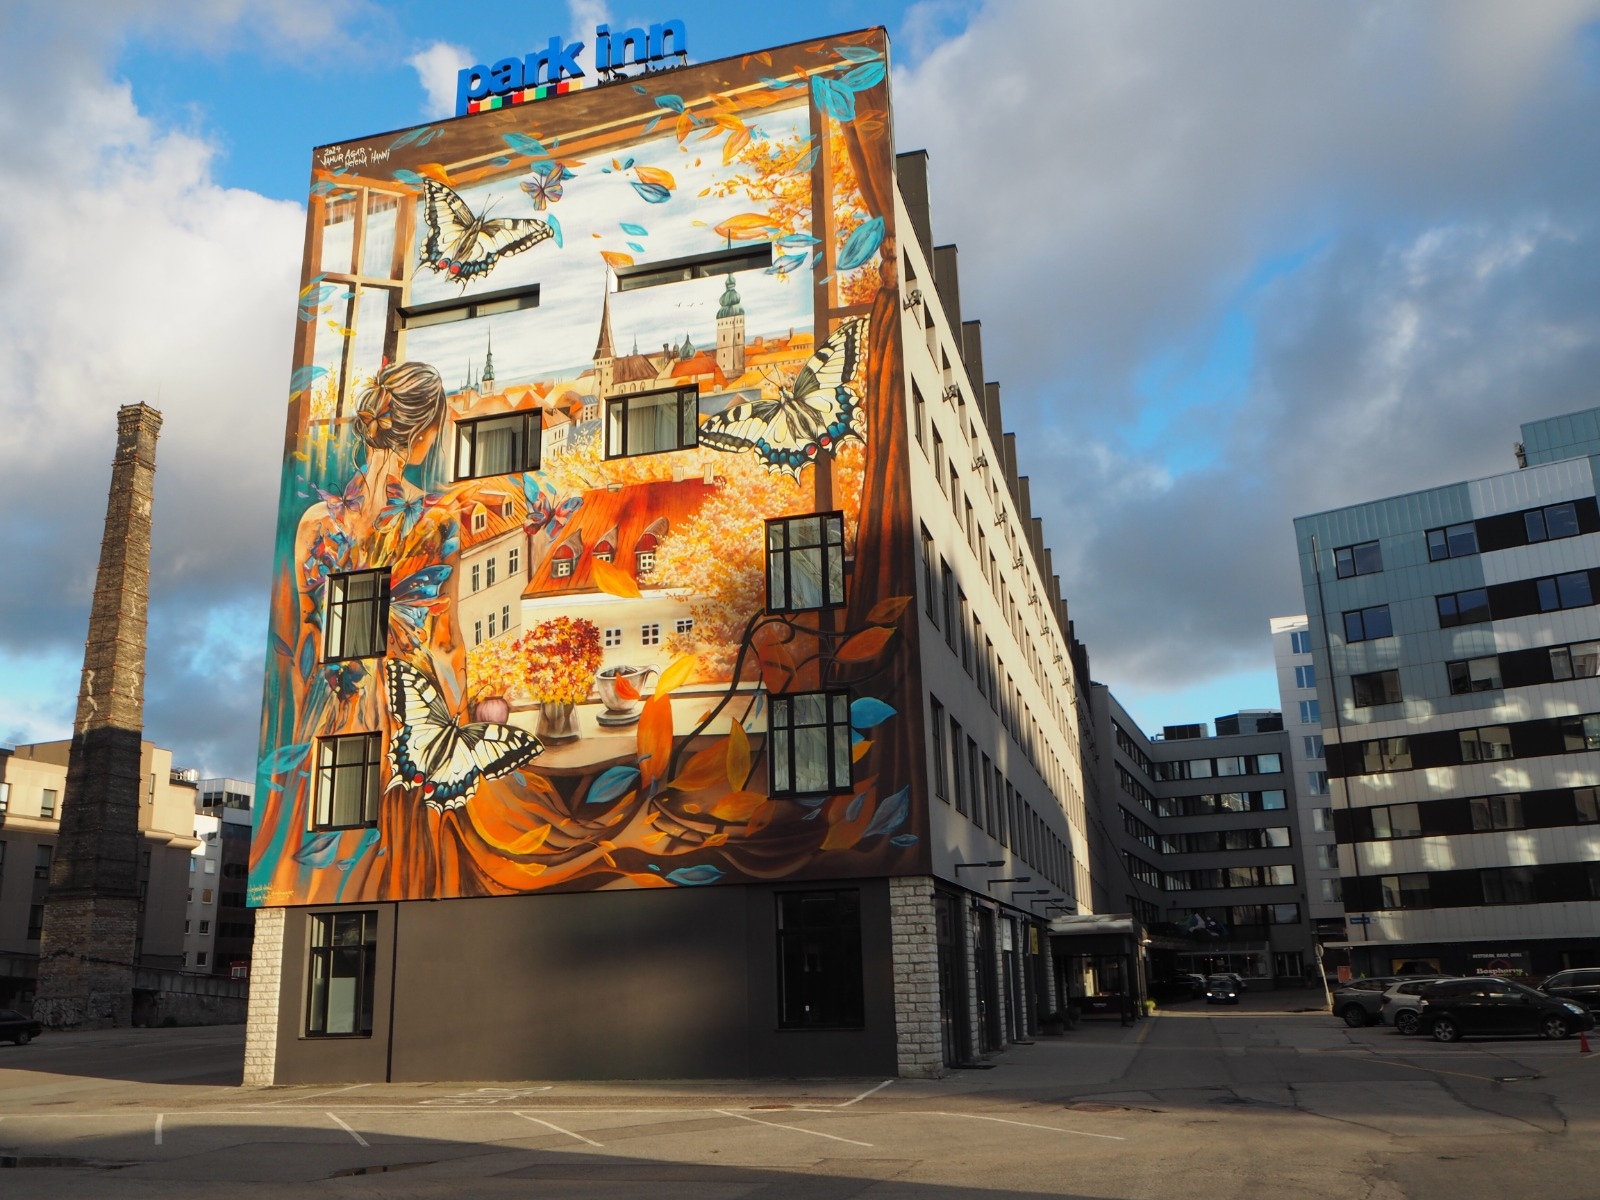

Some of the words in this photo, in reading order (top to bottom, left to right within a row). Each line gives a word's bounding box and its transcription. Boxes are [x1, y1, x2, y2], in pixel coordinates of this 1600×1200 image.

[455, 35, 586, 117] park
[595, 19, 688, 73] inn
[324, 146, 342, 156] 2024
